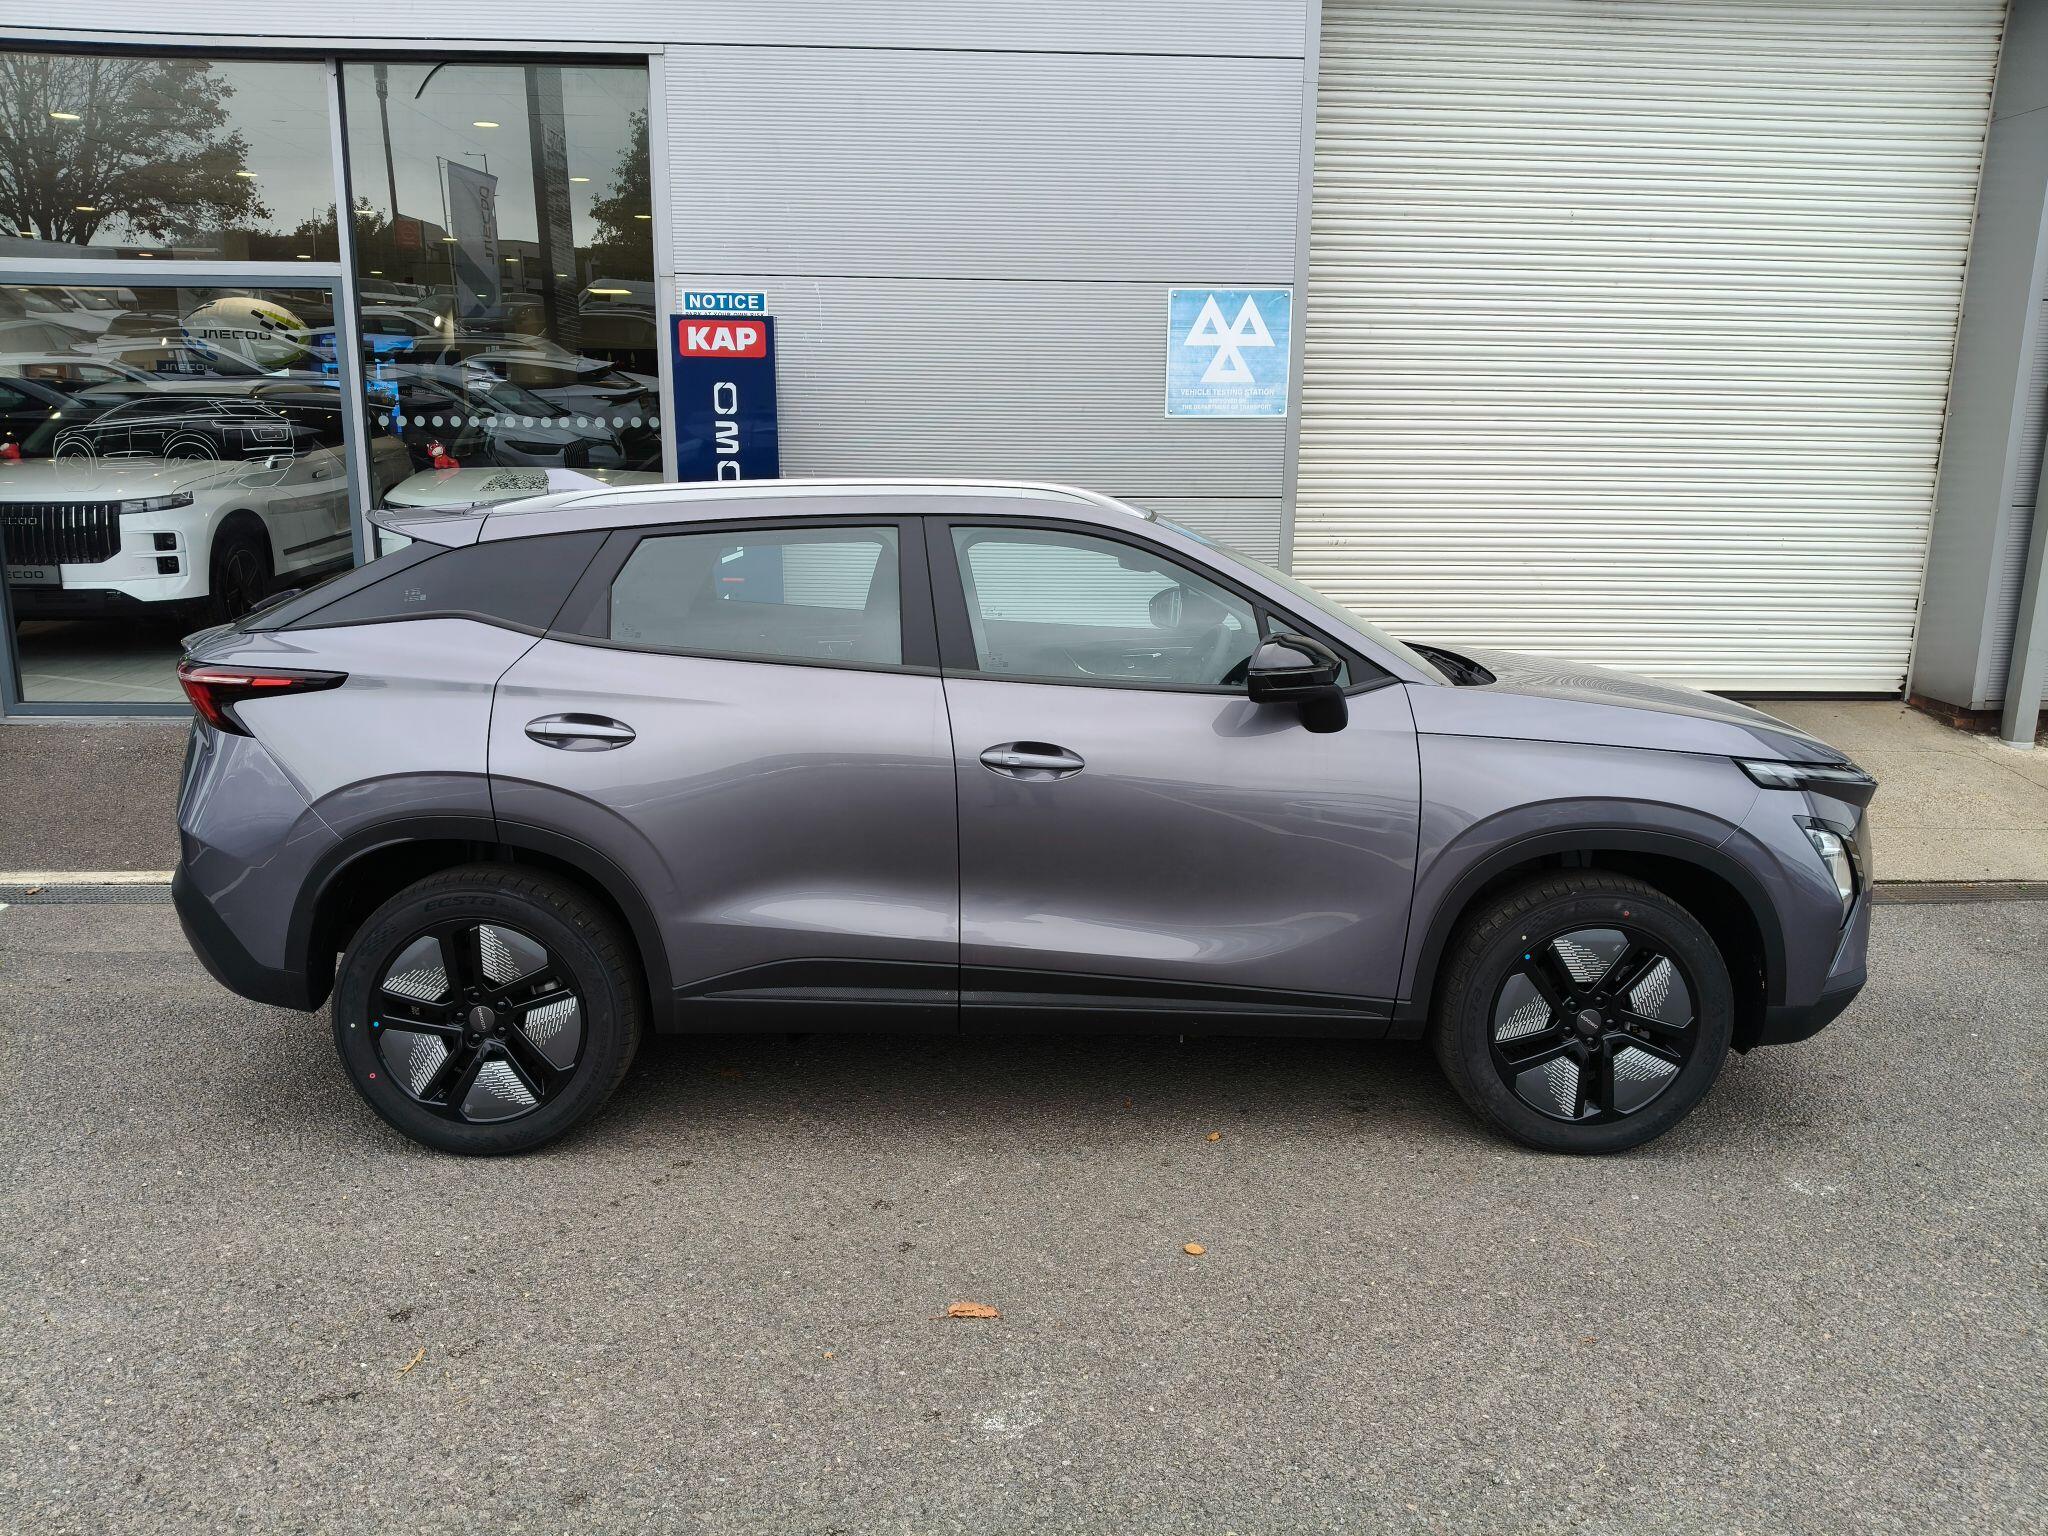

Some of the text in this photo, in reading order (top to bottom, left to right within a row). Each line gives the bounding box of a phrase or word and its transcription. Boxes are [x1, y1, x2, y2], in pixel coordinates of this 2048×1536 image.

[689, 294, 759, 309] NOTICE
[199, 329, 272, 341] JAECOO
[687, 326, 758, 351] KAP
[1180, 388, 1211, 396] VEHICLE
[1244, 388, 1275, 396] STATION
